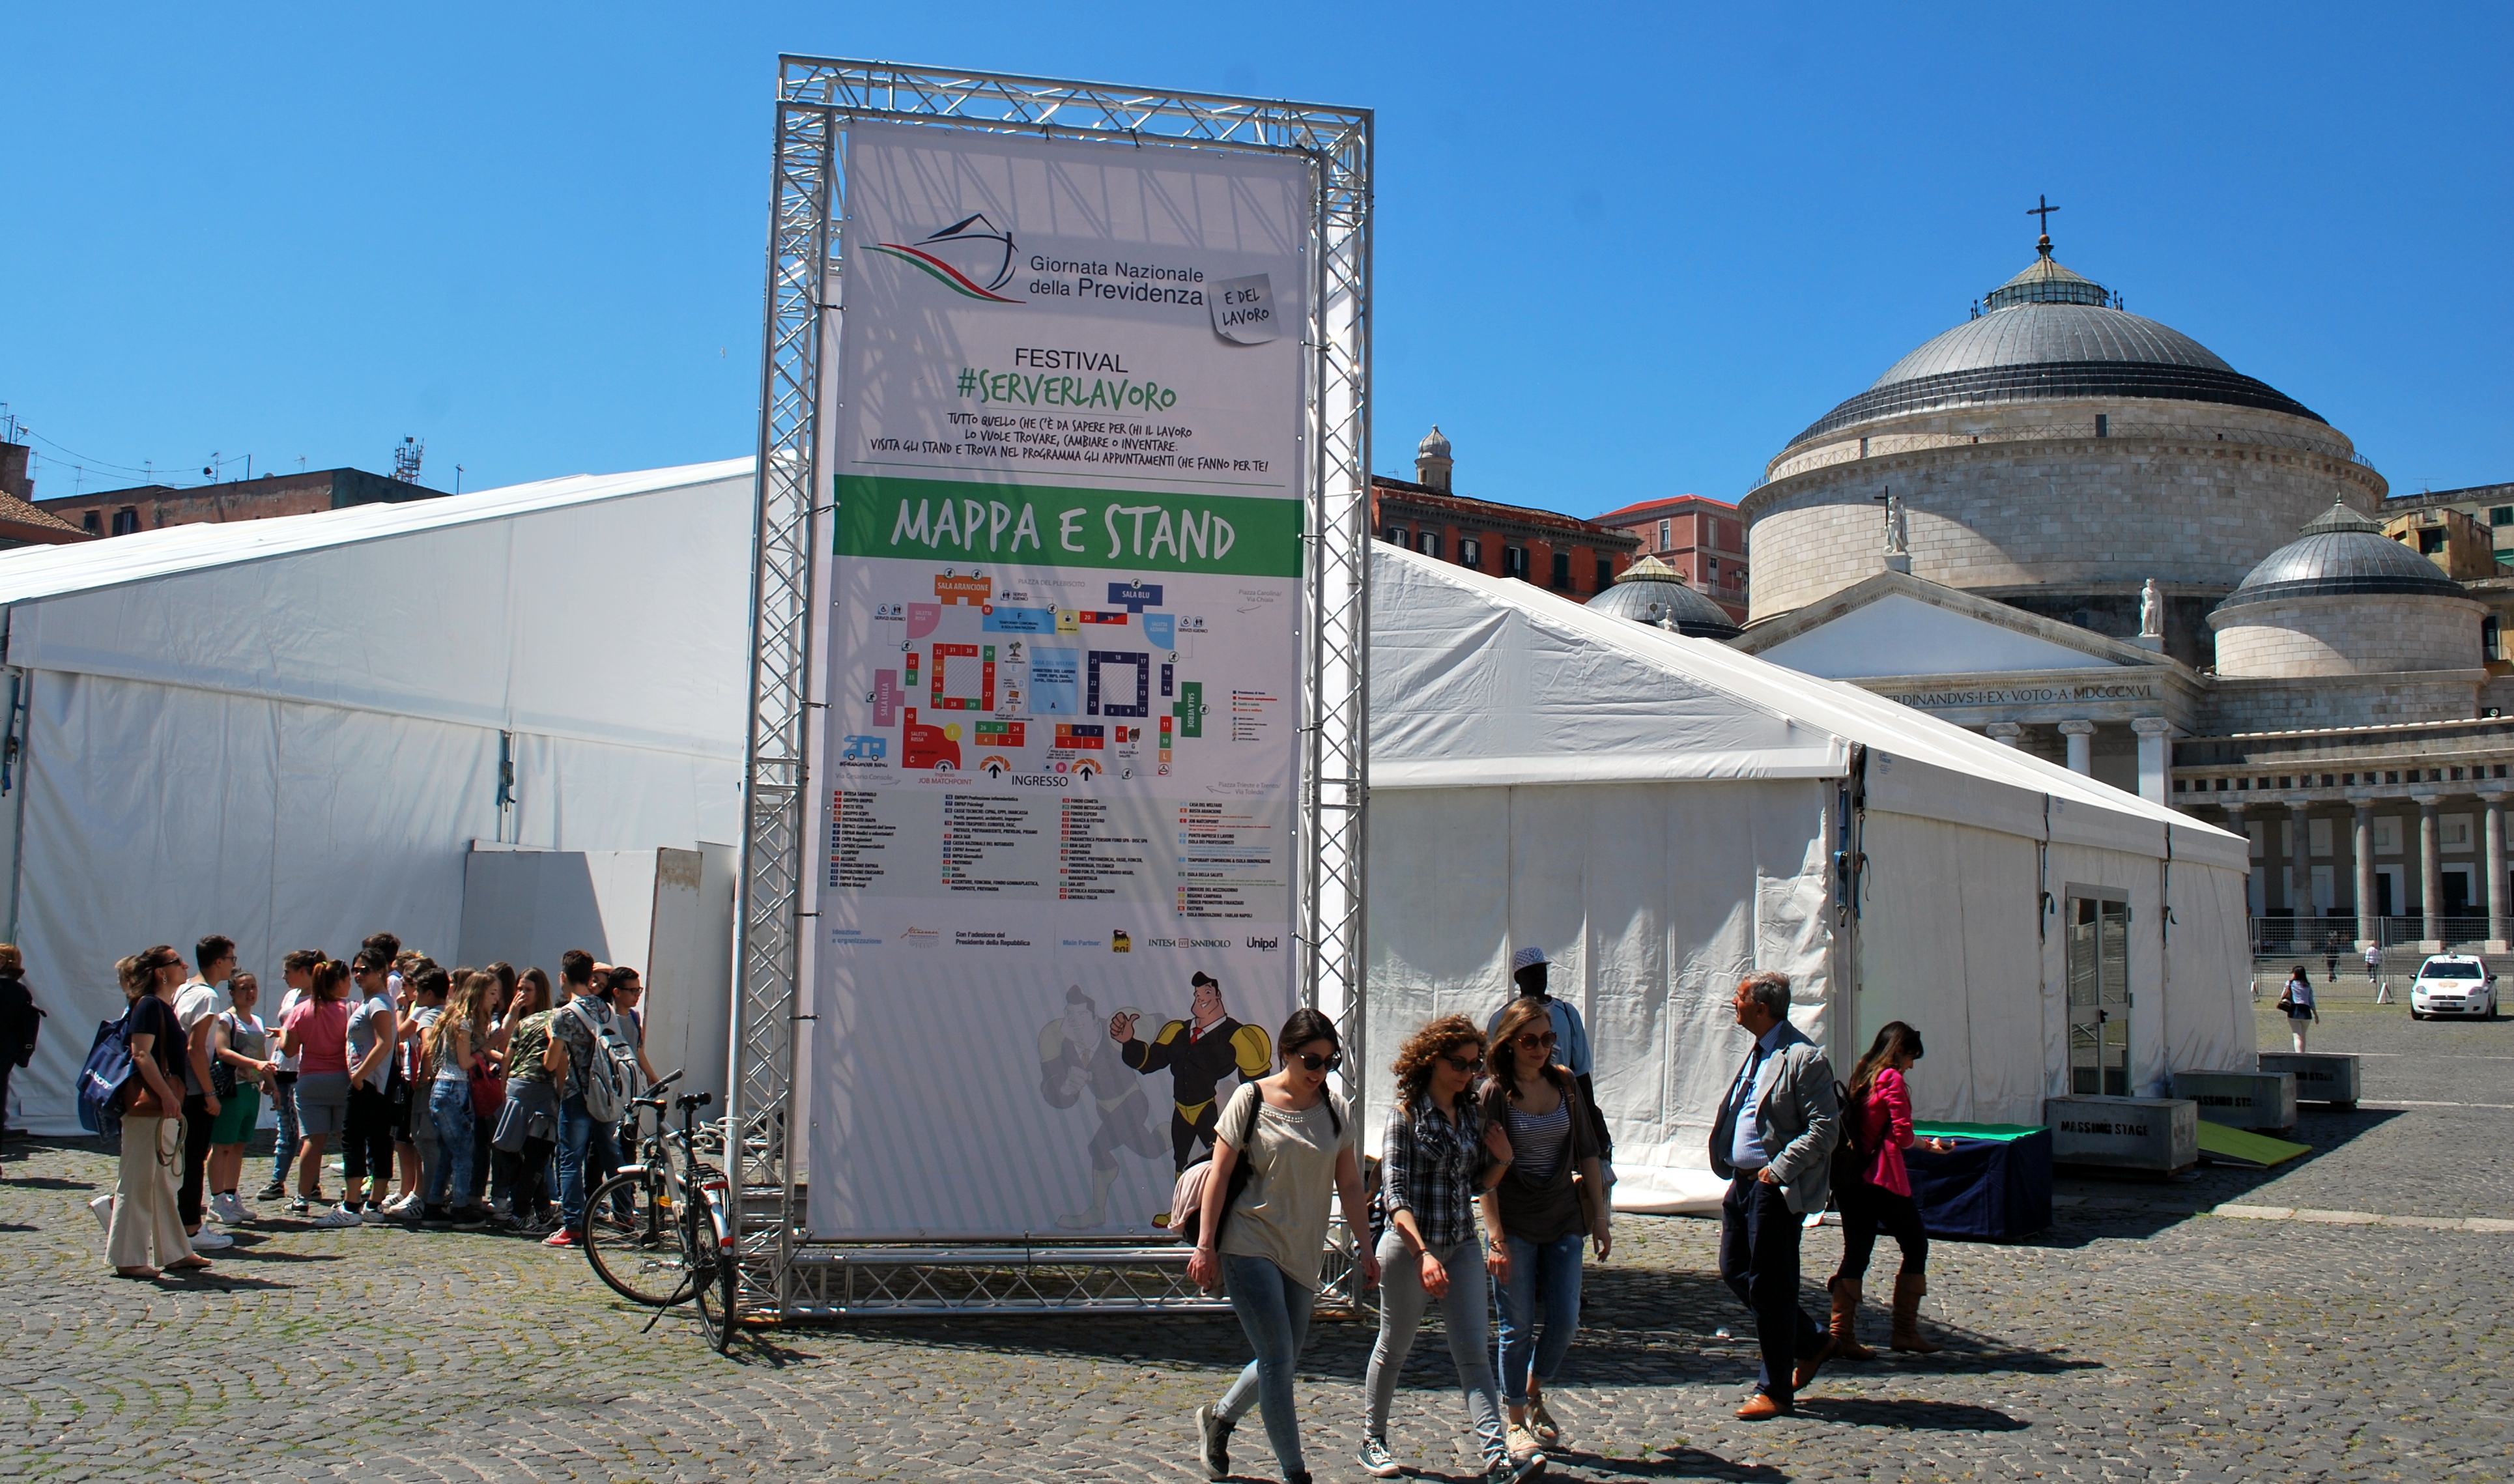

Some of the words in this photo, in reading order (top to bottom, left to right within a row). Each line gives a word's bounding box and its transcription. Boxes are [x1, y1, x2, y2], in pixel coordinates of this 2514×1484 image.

[1030, 255, 1108, 276] Giornata
[1115, 262, 1204, 283] Nazionale
[1029, 279, 1070, 296] della
[1078, 278, 1203, 306] Previdenza
[1224, 291, 1234, 305] E
[1238, 287, 1261, 303] DEL
[1222, 309, 1270, 326] LAVORO
[1015, 347, 1128, 373] FESTIVAL
[957, 367, 1177, 412] #SERVERLAVORO
[947, 412, 978, 425] TUTTO
[981, 415, 1016, 427] QUELLO
[1020, 416, 1036, 429] CHE
[1057, 420, 1068, 431] DA
[1072, 420, 1106, 433] SAPERE
[1109, 423, 1126, 435] PER
[1129, 423, 1142, 435] CHI
[1145, 426, 1154, 435] IL
[1157, 426, 1192, 438] LAVORO
[965, 429, 977, 440] LO
[980, 431, 1010, 443] VUOLE
[1014, 431, 1060, 447] TROVARE,
[1064, 434, 1109, 448] CAMBIARE
[1121, 438, 1178, 451] INVENTARE.
[870, 438, 900, 451] VISITA
[903, 440, 919, 453] GLI
[922, 440, 952, 455] STAND
[956, 444, 962, 455] E
[965, 444, 997, 457] TROVA
[1001, 446, 1019, 458] NEL
[1023, 447, 1081, 461] PROGRAMMA
[1084, 451, 1099, 463] GLI
[1102, 451, 1174, 467] APPUNTAMENTI
[1178, 456, 1194, 469] CHE
[1197, 457, 1230, 470] FANNO
[1233, 459, 1251, 472] PER
[1253, 460, 1269, 472] TE!
[890, 498, 1040, 554] MAPPA
[1059, 507, 1087, 552] E
[1104, 503, 1235, 564] STAND
[937, 582, 952, 590] SALA
[1011, 775, 1068, 787] INGRESSO
[1113, 945, 1129, 953] eni
[1149, 939, 1176, 947] INTESA
[1190, 939, 1231, 948] SANPAOLO
[1246, 937, 1278, 952] Unipol
[2115, 1123, 2148, 1136] STAGE
